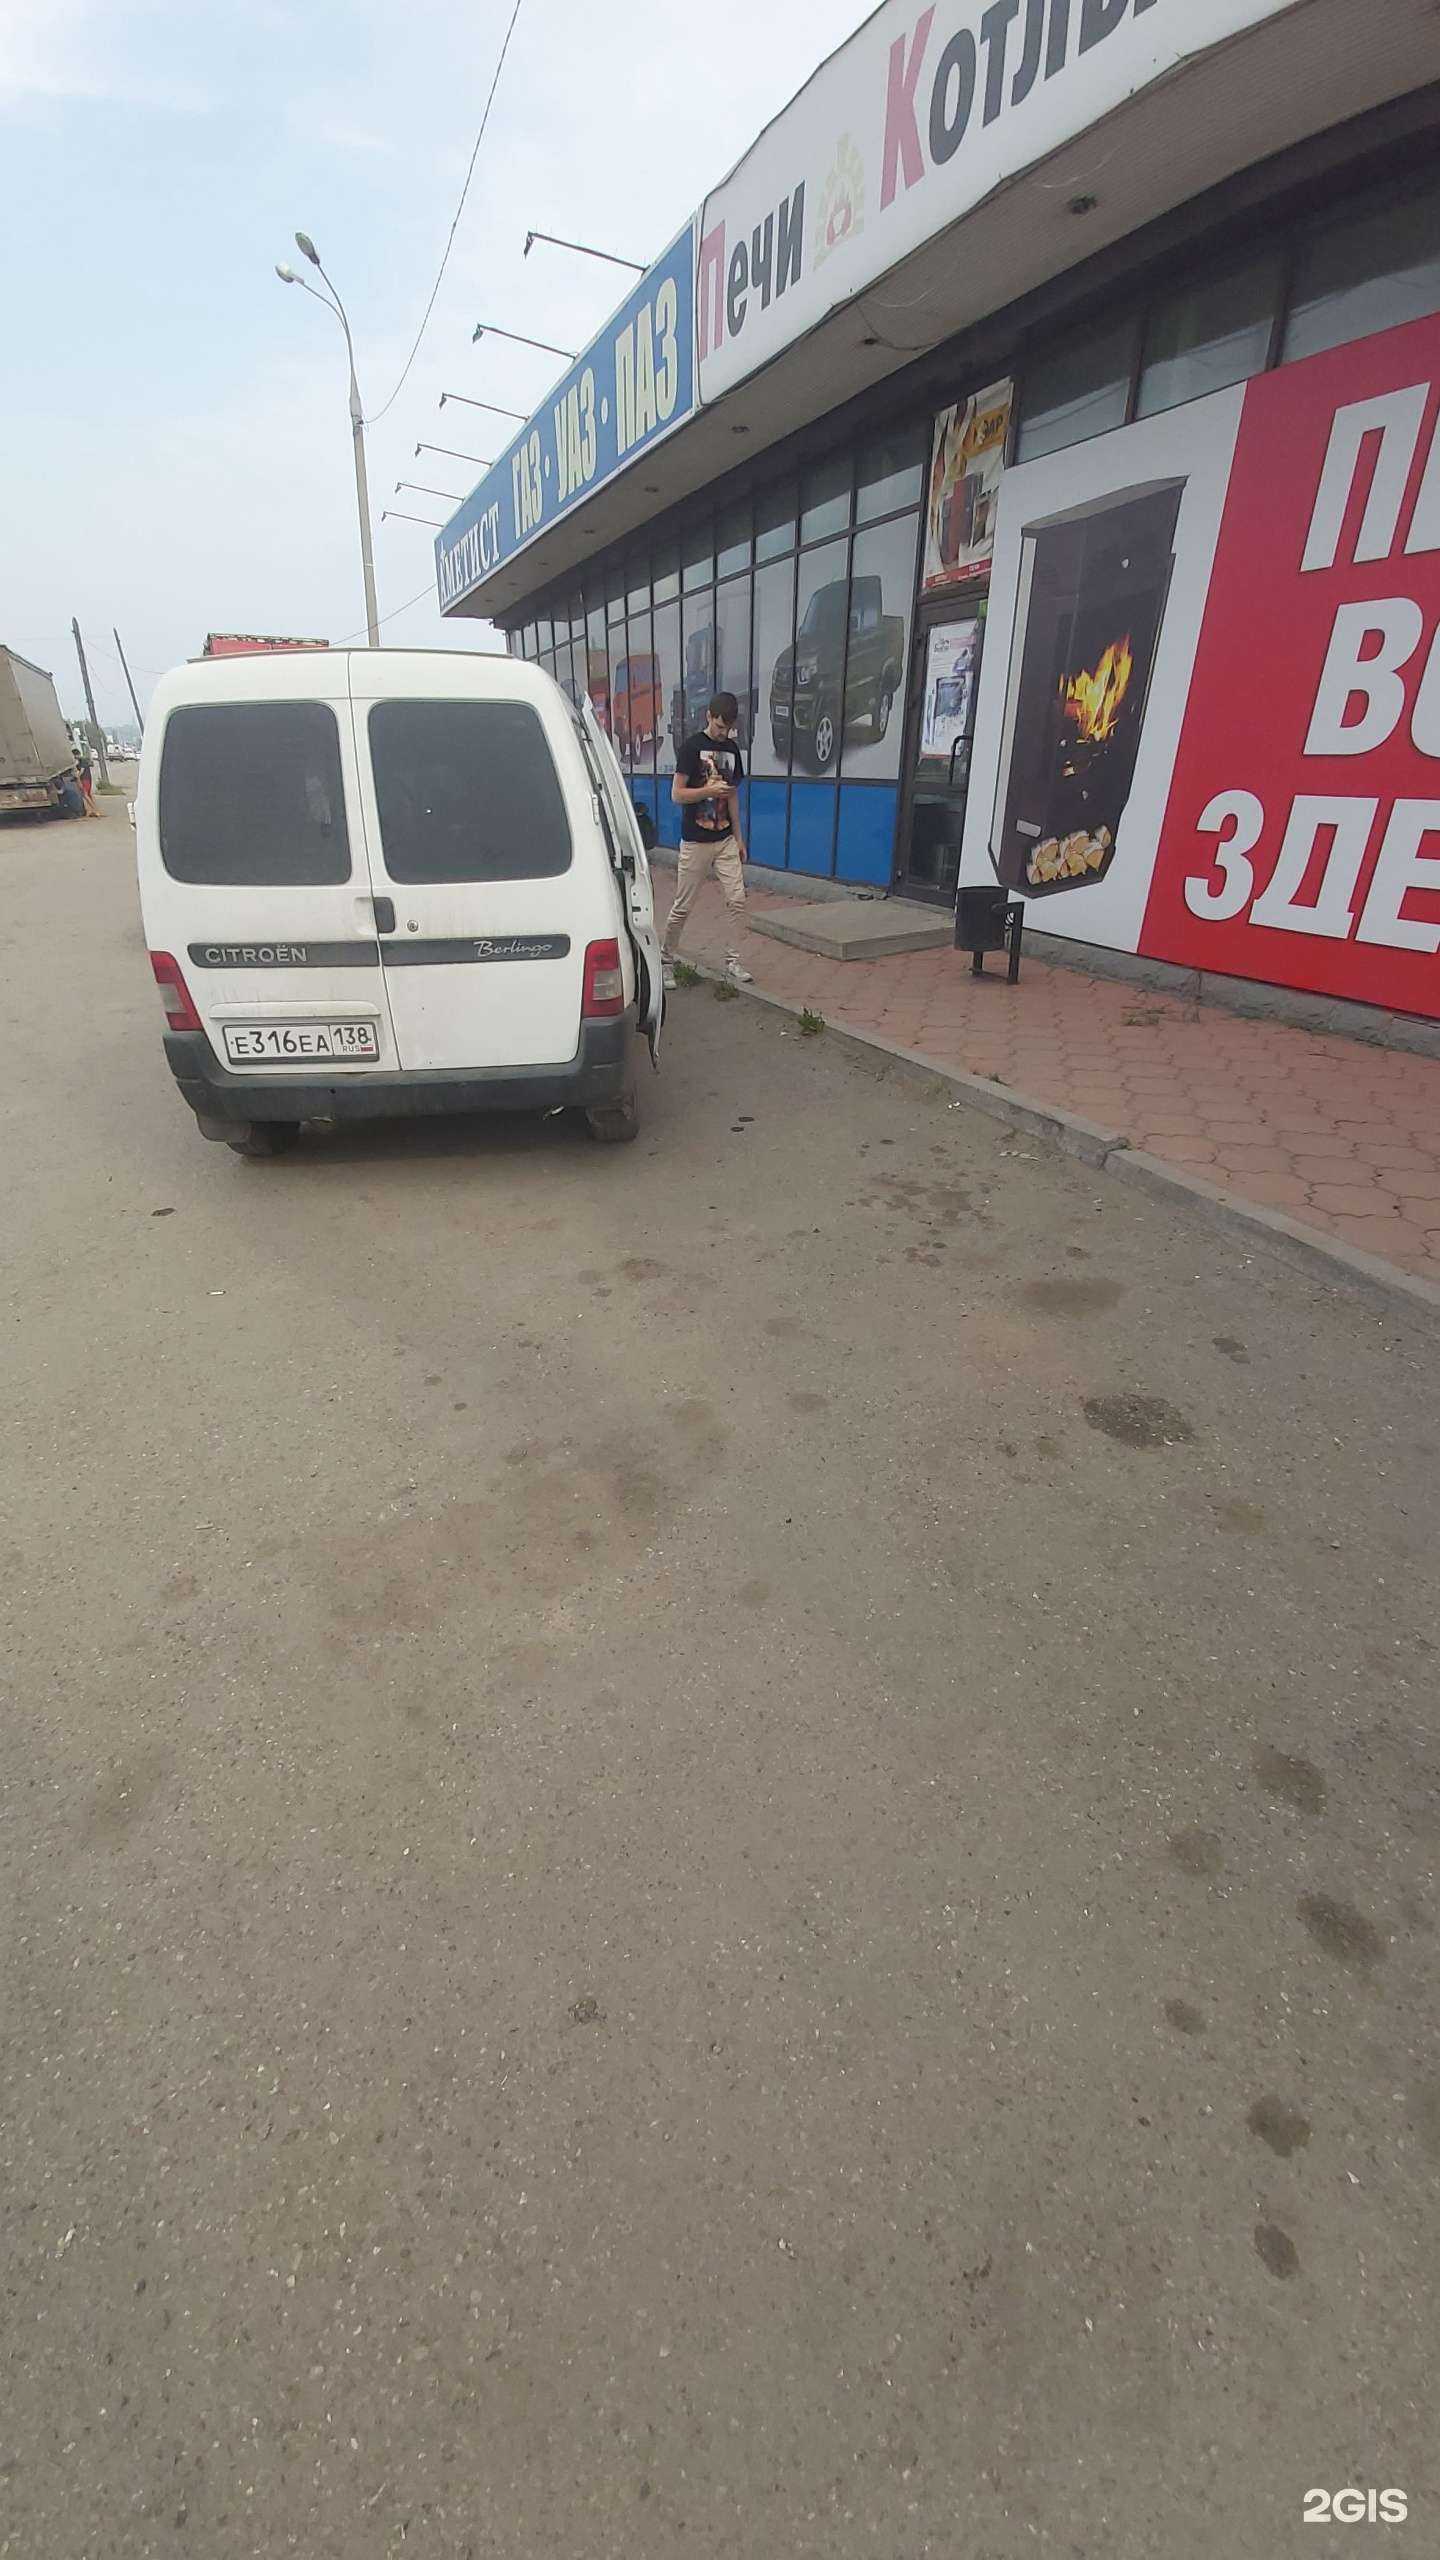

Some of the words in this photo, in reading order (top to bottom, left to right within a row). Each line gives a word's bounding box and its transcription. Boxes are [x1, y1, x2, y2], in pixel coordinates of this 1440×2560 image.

[700, 180, 805, 360] Печи
[511, 430, 542, 539] ГАЗ
[554, 367, 598, 503] УАЗ
[615, 277, 677, 456] ПАЗ
[206, 944, 307, 963] CITROËN
[473, 940, 552, 957] Berlingo
[333, 1027, 371, 1045] 138
